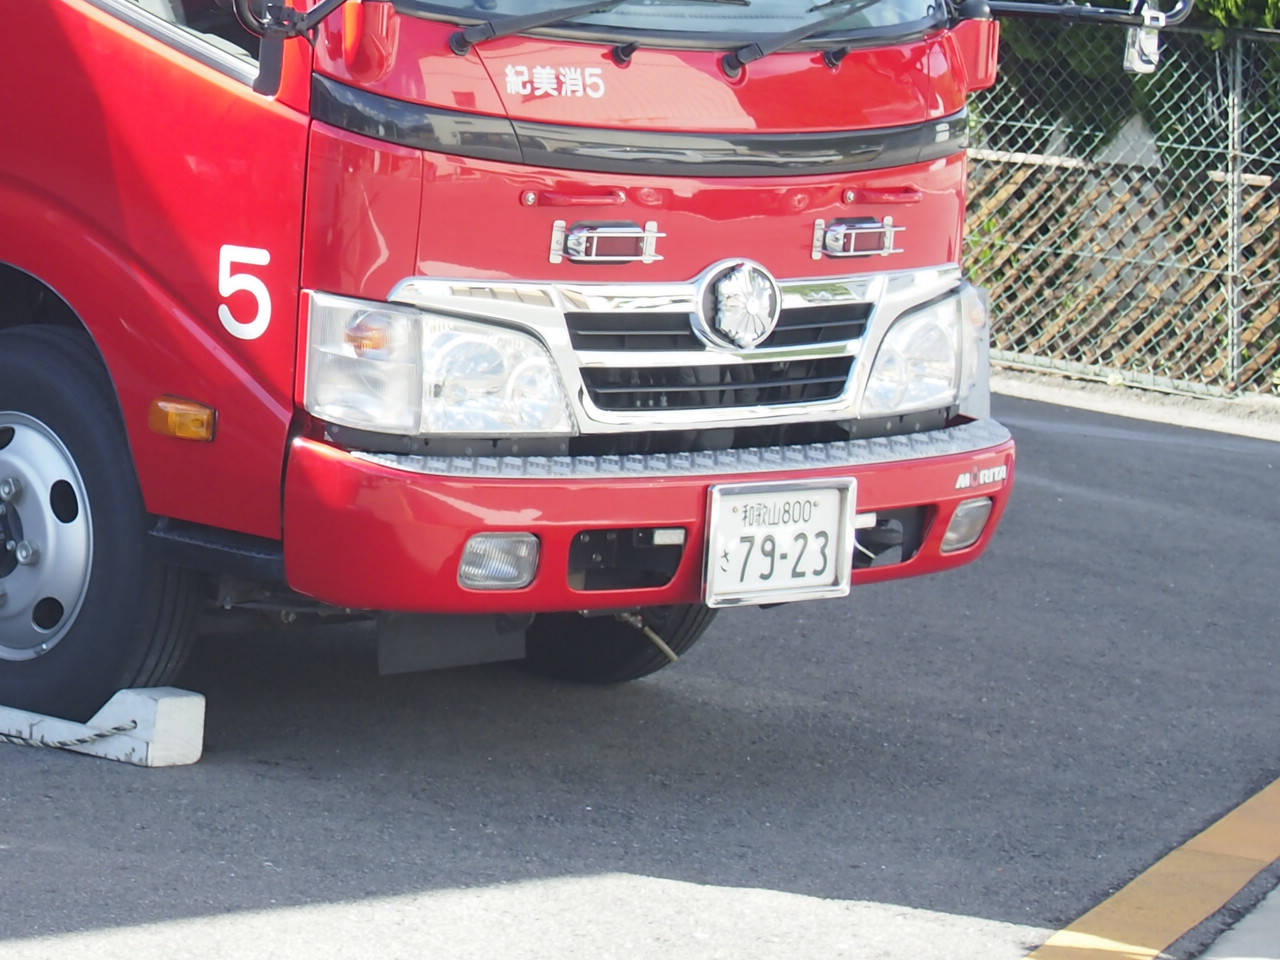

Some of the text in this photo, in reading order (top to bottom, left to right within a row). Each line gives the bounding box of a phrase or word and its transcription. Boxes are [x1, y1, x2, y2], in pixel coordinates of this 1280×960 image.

[505, 64, 605, 98] 紀美消5
[218, 244, 271, 340] 5
[739, 530, 830, 583] 79-23
